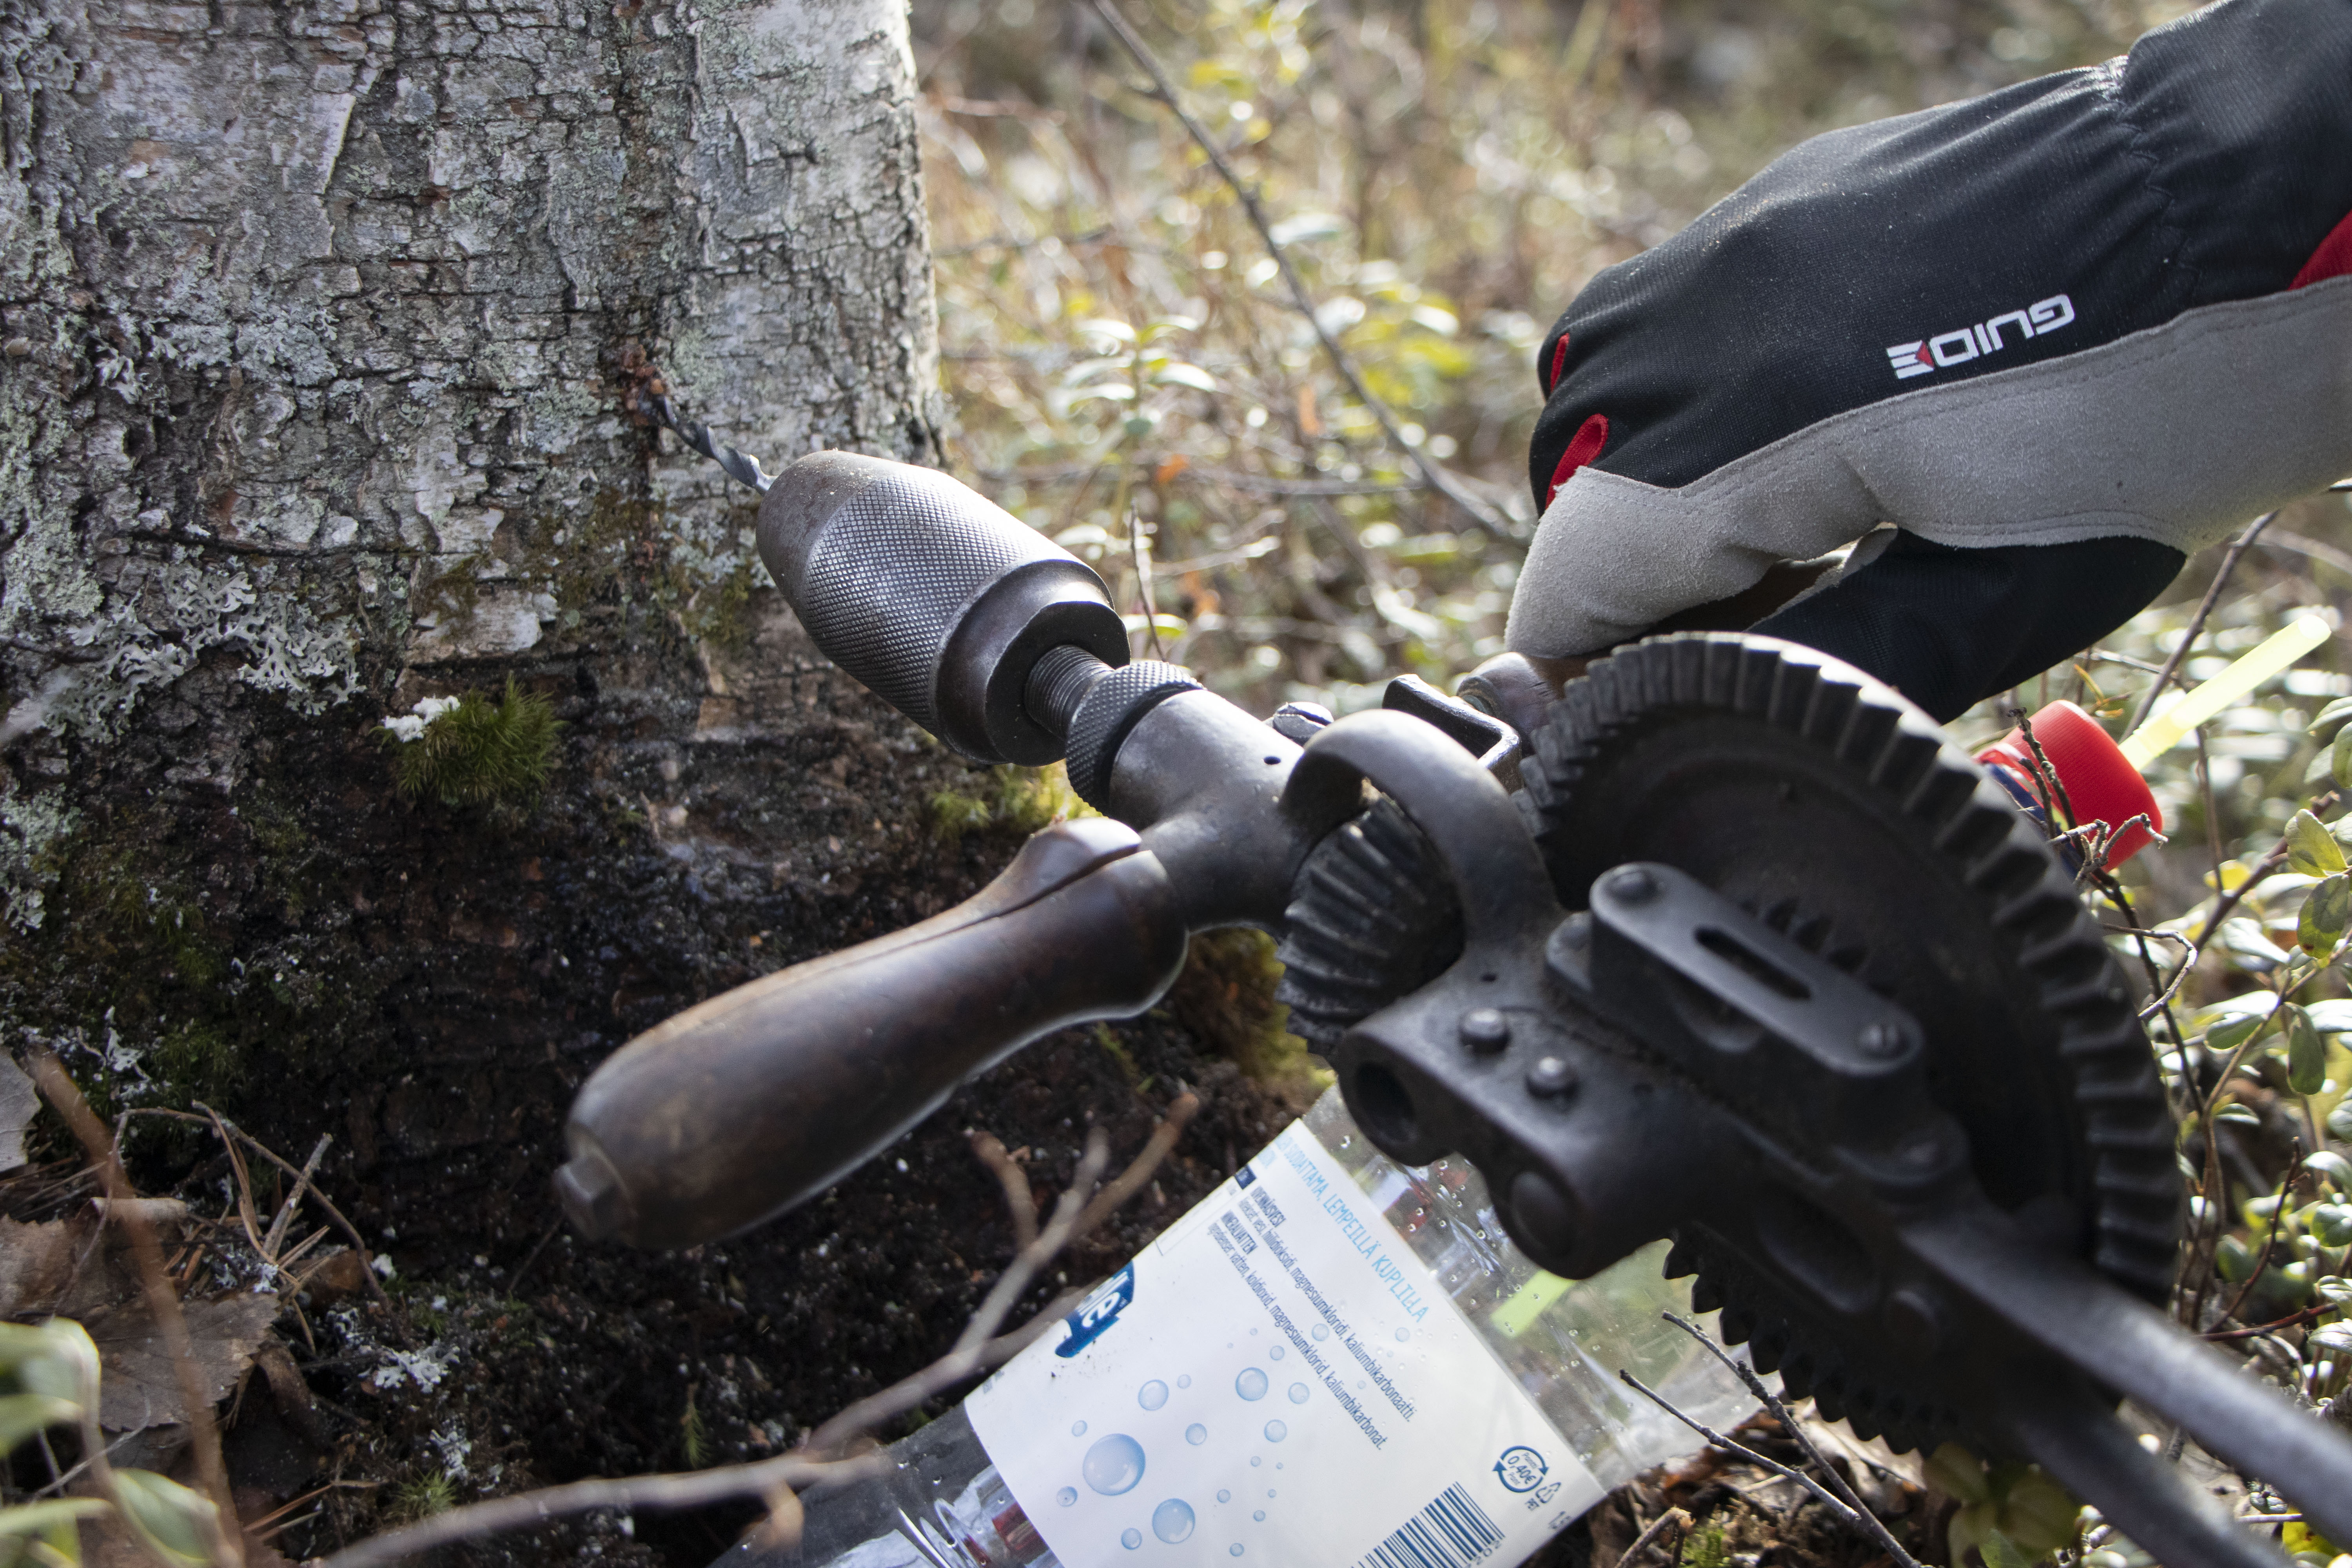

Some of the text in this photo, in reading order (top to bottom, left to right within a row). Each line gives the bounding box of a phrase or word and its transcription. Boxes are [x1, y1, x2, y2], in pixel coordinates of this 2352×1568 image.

[1886, 294, 2075, 379] GUIDE
[1322, 1193, 1381, 1260] LEMPEILLÄ
[1371, 1254, 1429, 1323] KUPLILLA
[1229, 1251, 1250, 1278] vatten,
[1245, 1270, 1277, 1310] koldioxid,
[1269, 1305, 1330, 1379] magnesiumklorid,
[1323, 1371, 1388, 1450] kaliumbikarbonat.
[1290, 1267, 1350, 1340] magnesiumkloridi,
[1343, 1332, 1417, 1422] kaliumbikarbonaatti.
[1507, 1455, 1536, 1484] 0,40€
[1524, 1497, 1540, 1511] PET
